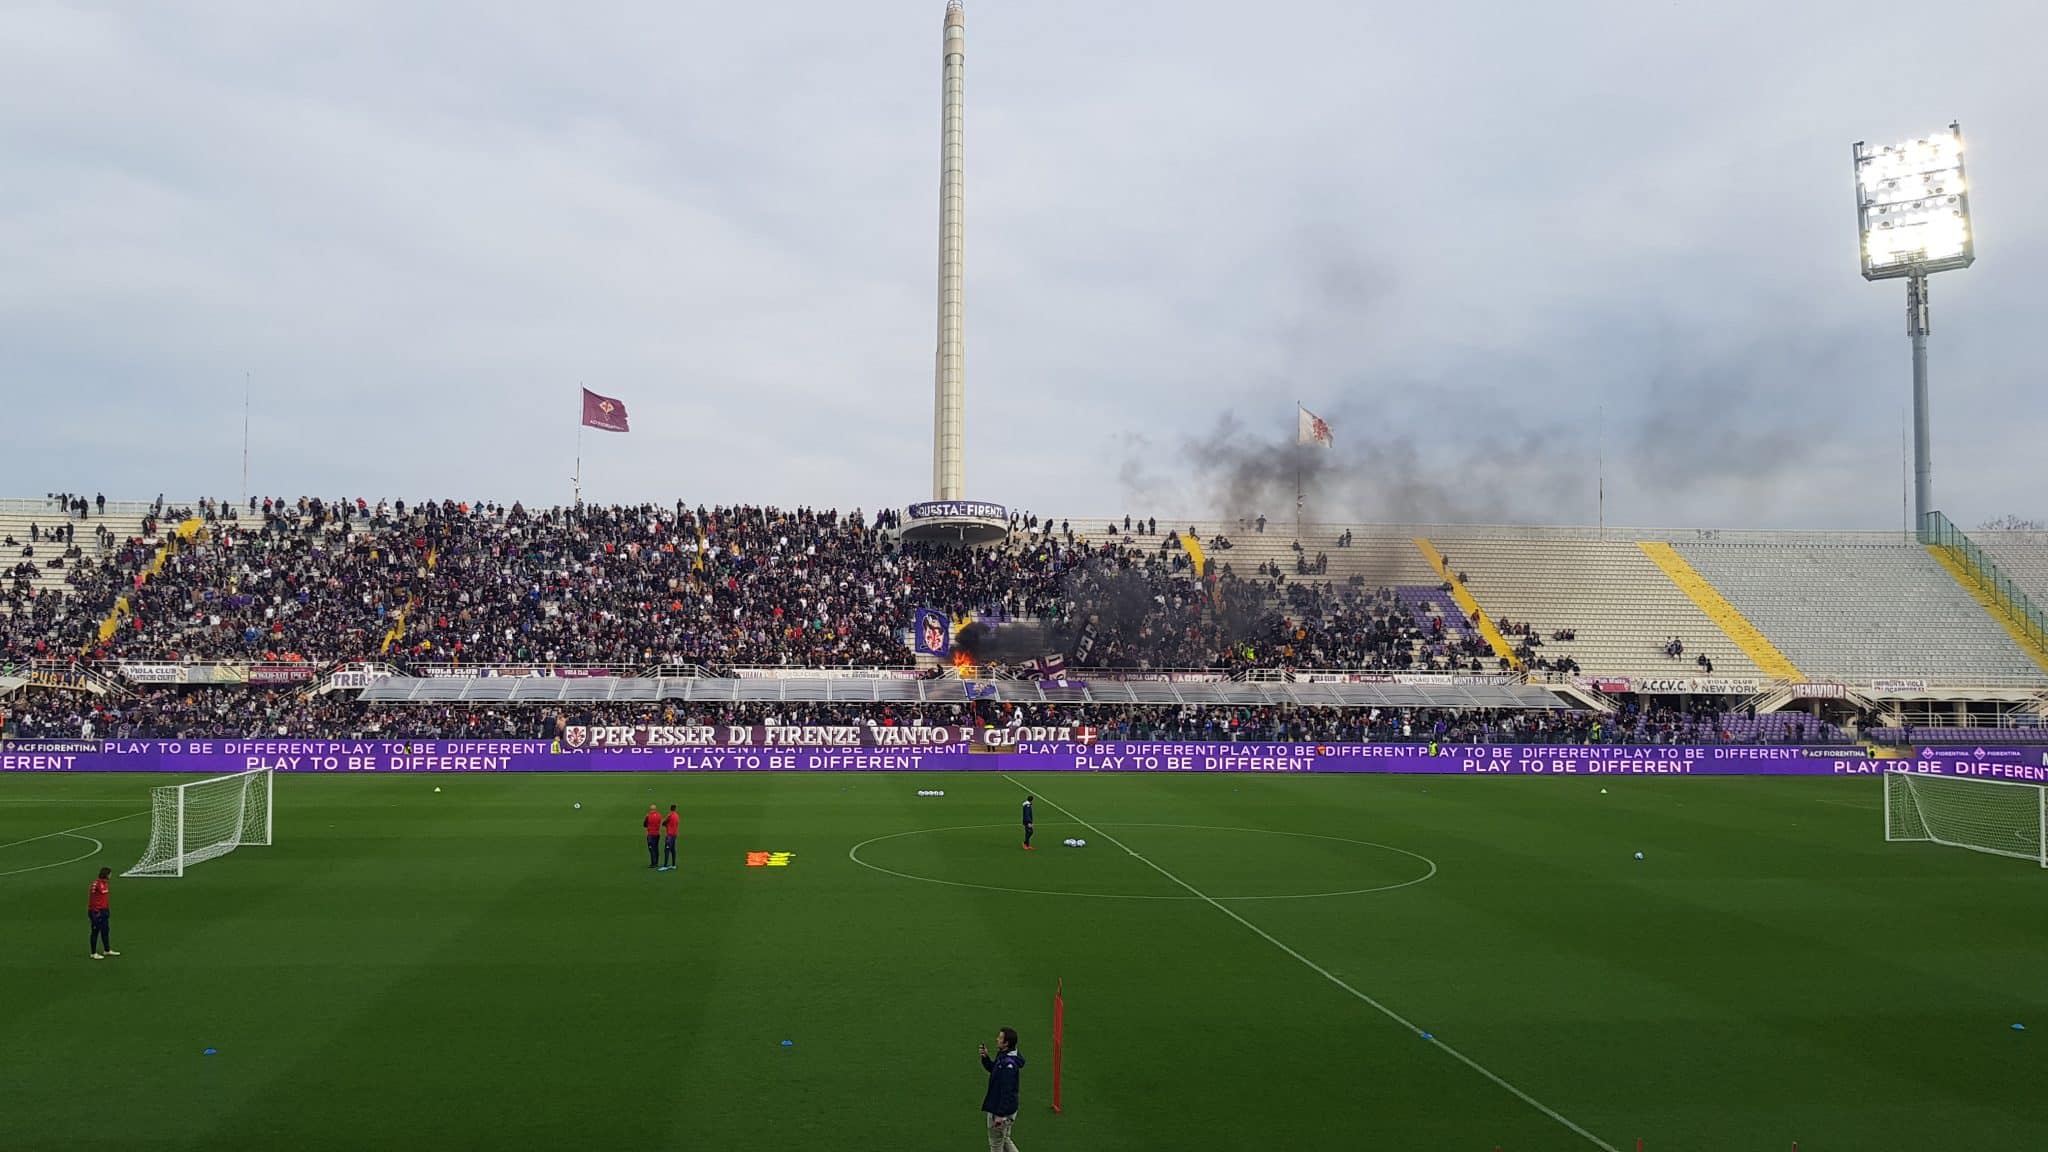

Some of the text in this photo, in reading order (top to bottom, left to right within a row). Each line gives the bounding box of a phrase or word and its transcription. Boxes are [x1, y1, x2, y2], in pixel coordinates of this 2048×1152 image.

[1701, 685, 1758, 693] NEW YORK
[589, 726, 636, 747] PER
[647, 726, 717, 746] ESSER
[728, 726, 753, 746] DI
[764, 726, 861, 746] FIRENZE
[870, 726, 949, 745] VANTO
[984, 727, 1071, 746] GLORIA
[17, 744, 97, 752] ACF FIORENTINA
[104, 743, 325, 754] PLAY TO BE DIFFERENT
[330, 743, 546, 754] PLAY TO BE DIFFERENT
[1018, 743, 1220, 755] PLAY TO BE DIFFERENT
[1220, 745, 1415, 757] PLAY TO BE DIFFERENT
[1418, 746, 1610, 758] PAY TO BE DIFFERENT
[1613, 748, 1799, 759] PLAY TO BE DIFFERENT
[0, 756, 76, 769] ERENT
[246, 757, 511, 770] PLAY TO BE DIFFERENT
[673, 756, 922, 769] PLAY TO BE DIFFERENT
[1075, 757, 1314, 771] PLAY TO BE DIFFERENT
[1463, 760, 1694, 773] PLAY TO BE DIFFERENT
[1834, 761, 1879, 773] PLAY
[1886, 761, 1909, 772] TO
[1918, 761, 1942, 773] BE
